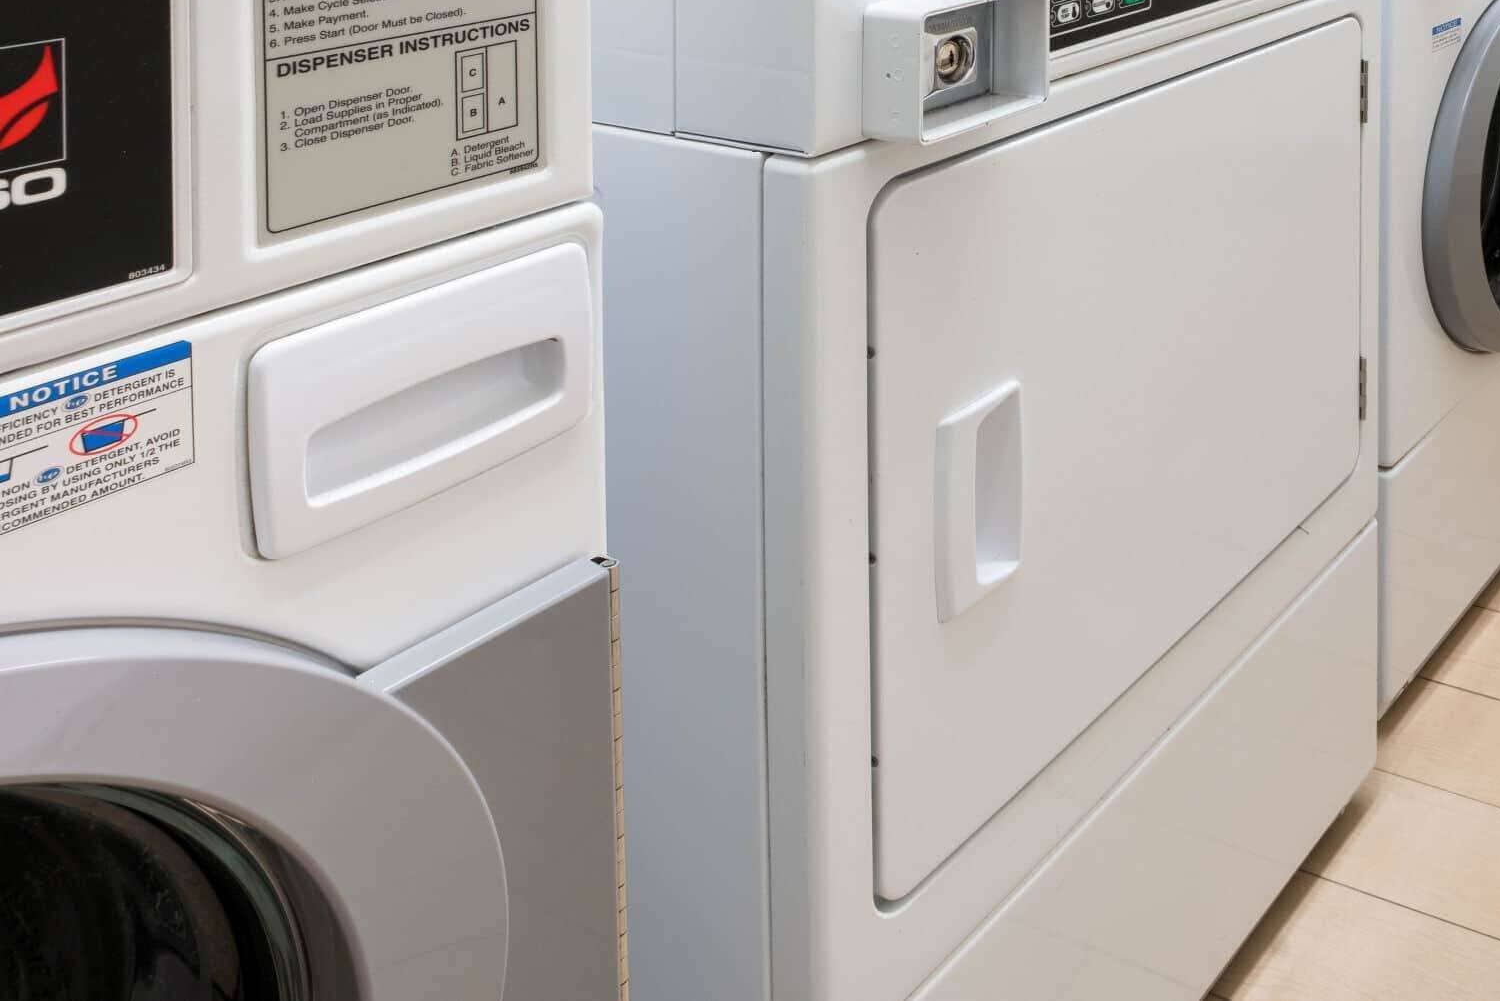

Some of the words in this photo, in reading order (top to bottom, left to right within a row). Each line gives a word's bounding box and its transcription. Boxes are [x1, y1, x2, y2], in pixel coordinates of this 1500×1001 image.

[269, 9, 279, 18] 4.
[283, 4, 315, 16] Make
[318, 0, 349, 12] Cycle
[269, 24, 280, 33] 5.
[284, 19, 315, 31] Make
[319, 10, 368, 25] Payment.
[269, 39, 280, 48] 6.
[284, 35, 316, 46] Press
[320, 28, 345, 40] Start
[349, 22, 378, 36] (Door
[381, 18, 407, 29] Must
[410, 15, 422, 24] be
[425, 7, 467, 21] Closed).
[277, 44, 393, 78] DISPENSER
[400, 19, 530, 54] INSTRUCTIONS
[469, 68, 477, 77] C
[294, 104, 325, 118] Open
[329, 92, 383, 110] Dispenser
[386, 85, 413, 98] Door.
[294, 114, 322, 128] Load
[326, 104, 372, 121] Supplies
[376, 100, 384, 109] in
[388, 93, 422, 107] Proper
[294, 114, 369, 138] Compartment
[373, 110, 389, 123] (as
[392, 98, 443, 116] Indicated).
[470, 108, 477, 117] B
[498, 97, 506, 106] A
[294, 135, 327, 149] Close
[331, 122, 384, 140] Dispenser
[388, 115, 414, 128] Door.
[464, 136, 510, 154] Detergent
[464, 150, 492, 165] Liquid
[495, 141, 525, 156] Bleach
[464, 159, 494, 173] Fabric
[496, 149, 534, 165] Softener
[0, 167, 67, 210] O
[0, 407, 58, 434] FICIENCY
[94, 373, 162, 402] DETERGENT
[165, 369, 175, 380] IS
[10, 365, 118, 411] NOTICE
[37, 419, 61, 433] FOR
[65, 407, 95, 423] BEST
[99, 377, 184, 412] PERFORMANCE
[2, 481, 31, 498] NON
[146, 428, 181, 446] AVOID
[41, 482, 58, 495] BY
[62, 466, 101, 486] USING
[105, 454, 136, 471] ONLY
[141, 447, 156, 459] 1/2
[158, 438, 180, 450] THE
[51, 457, 160, 502] MANUFACTURERS
[91, 473, 145, 498] AMOUNT.
